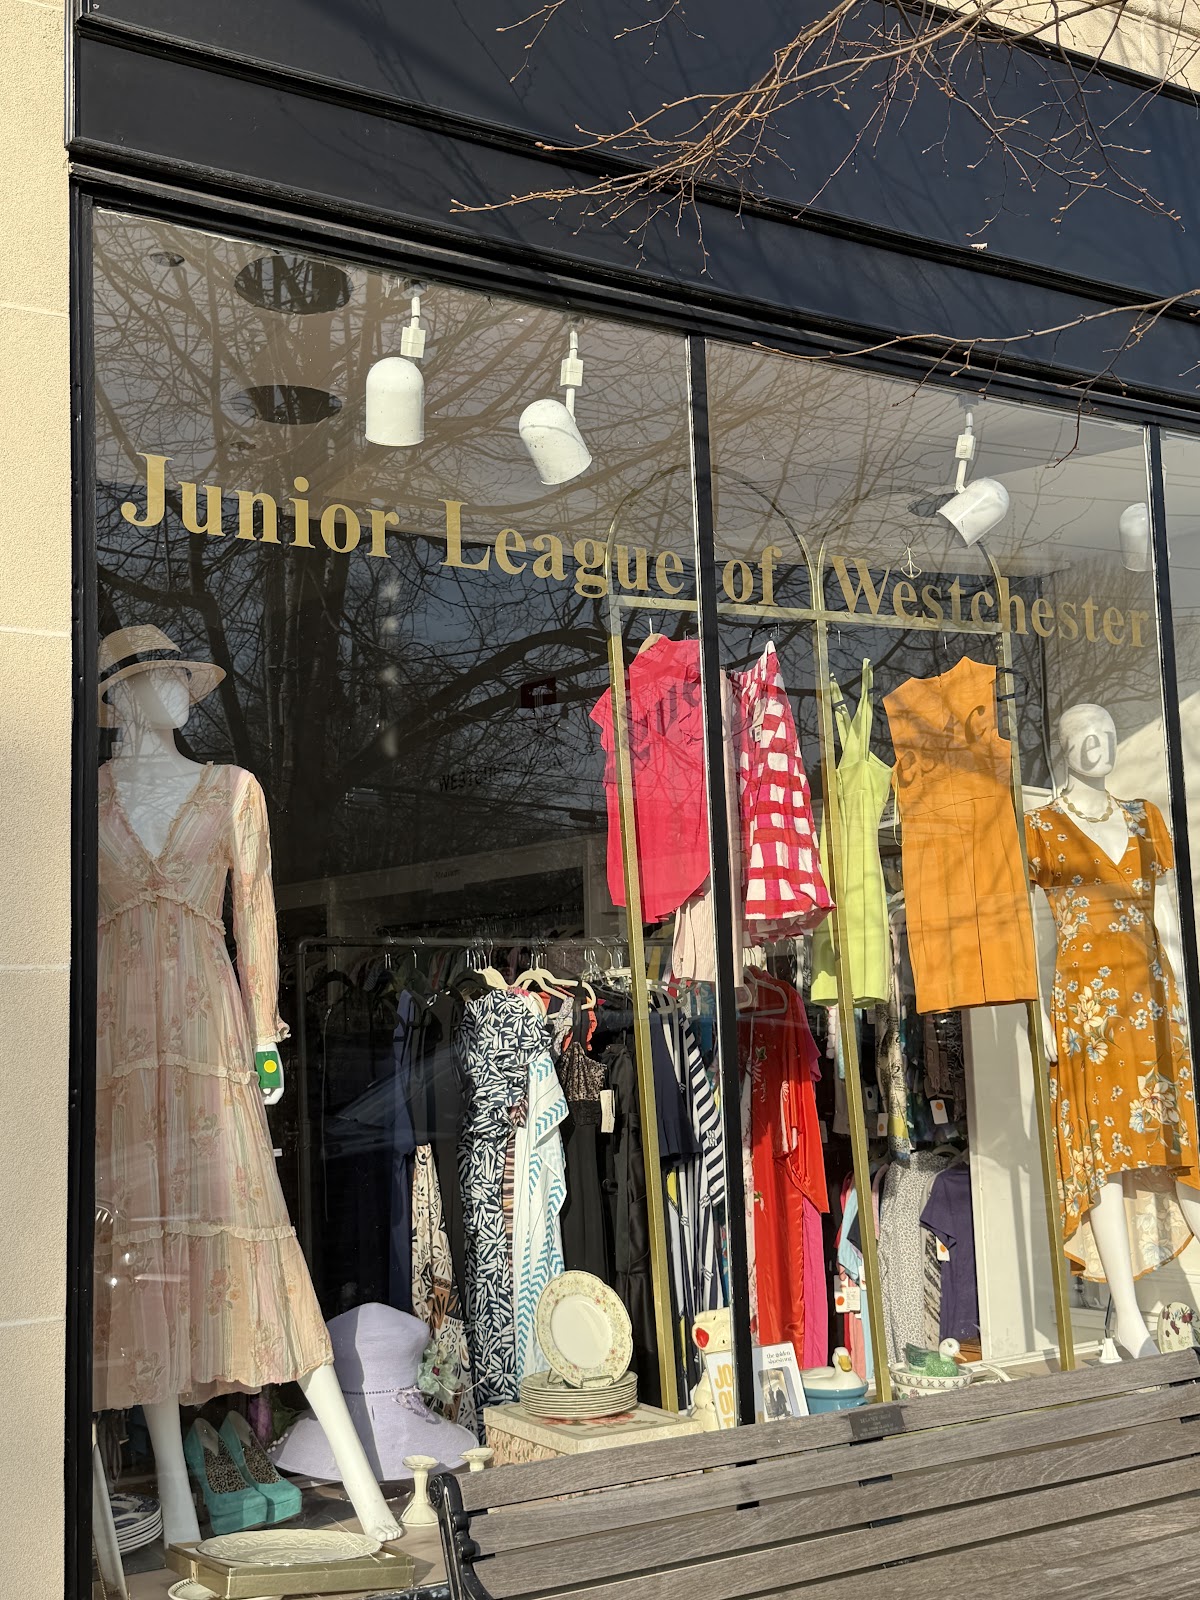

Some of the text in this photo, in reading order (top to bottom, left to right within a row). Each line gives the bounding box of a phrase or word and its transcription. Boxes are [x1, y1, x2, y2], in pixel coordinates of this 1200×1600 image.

[120, 452, 1150, 648] Junior League of Westchester
